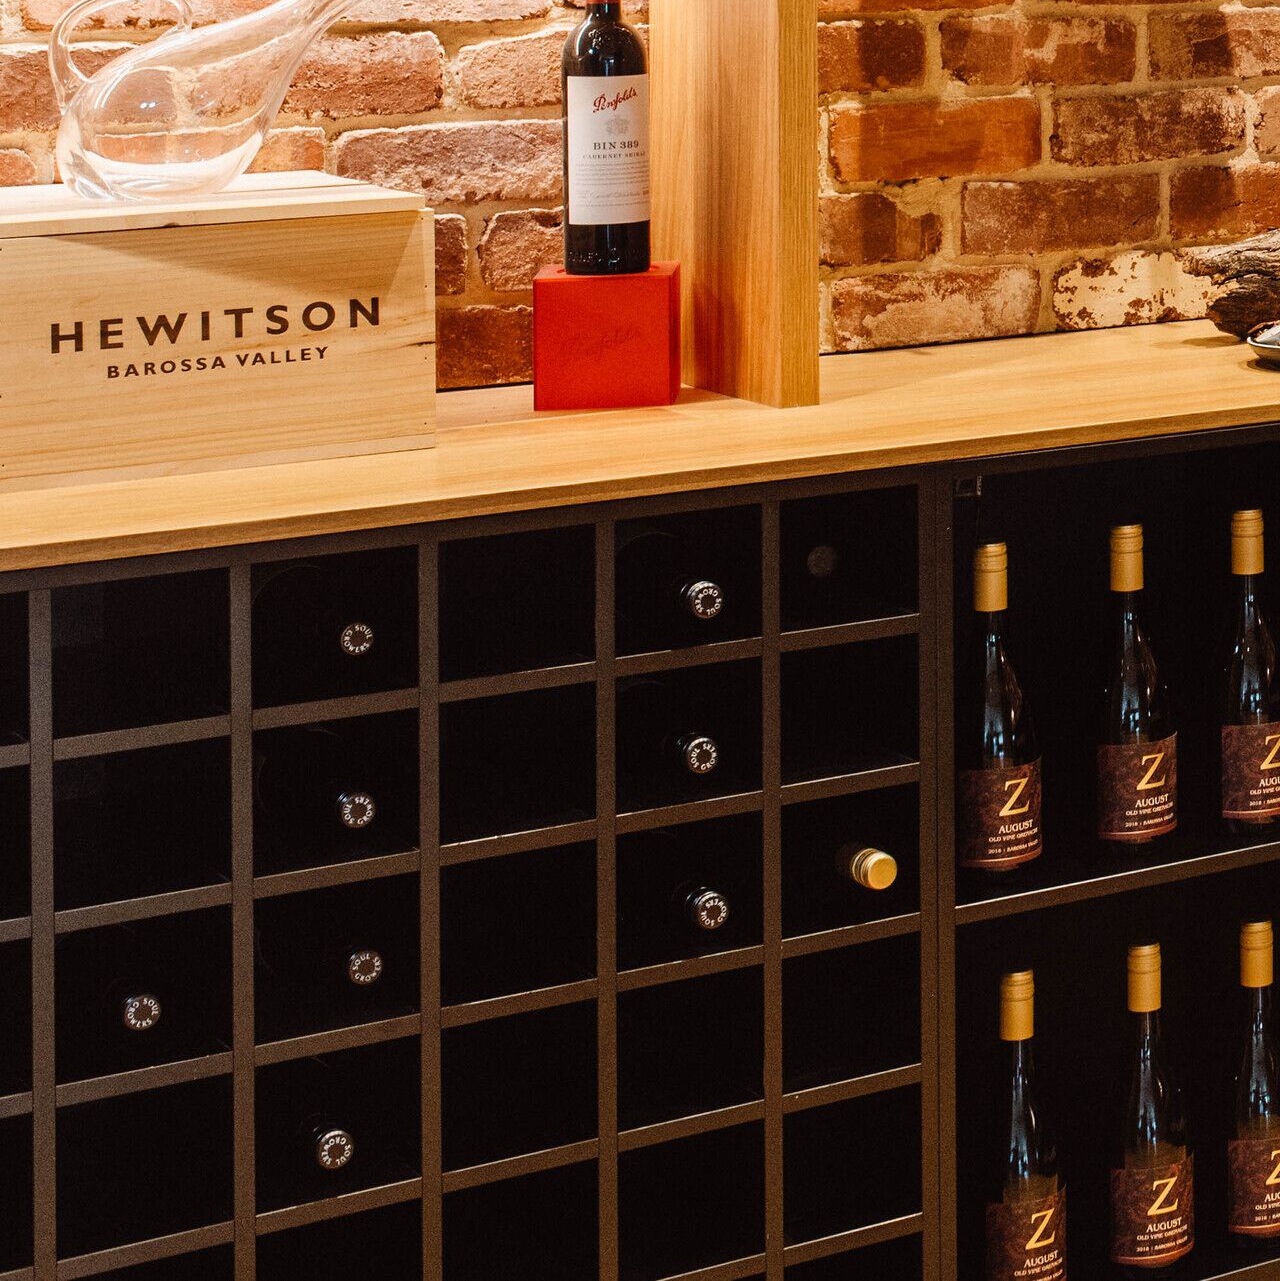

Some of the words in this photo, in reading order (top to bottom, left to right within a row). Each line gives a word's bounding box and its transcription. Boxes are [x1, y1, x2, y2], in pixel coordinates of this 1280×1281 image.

[593, 87, 639, 113] Penfolds
[593, 141, 617, 151] BIN
[620, 141, 639, 150] 389
[50, 296, 381, 354] HEWITSON
[107, 354, 226, 379] BAROSSA
[236, 346, 329, 368] VALLEY
[694, 588, 718, 613] GROWERS
[706, 598, 722, 616] SOUL
[344, 630, 369, 653] GROWERS
[355, 625, 373, 639] SOUL
[691, 747, 700, 768] SOUL
[700, 743, 717, 770] GROWERS
[1136, 752, 1165, 791] Z
[999, 776, 1029, 817] Z
[1135, 793, 1169, 808] AUGUST
[344, 803, 355, 824] SOUL
[354, 797, 373, 824] GROWERS
[998, 819, 1033, 834] AUGUST
[701, 910, 715, 927] SOUL
[705, 899, 727, 923] GROWERS
[352, 953, 370, 971] SOUL
[354, 956, 381, 982] GROWERS
[127, 1001, 152, 1028] GROWERS
[143, 997, 159, 1015] SOUL
[321, 1136, 347, 1165] GROWERS
[335, 1144, 352, 1165] SOUL
[1147, 1176, 1178, 1216] Z
[1025, 1208, 1055, 1250] Z
[1146, 1217, 1182, 1233] AUGUST
[1023, 1250, 1059, 1268] AUGUST
